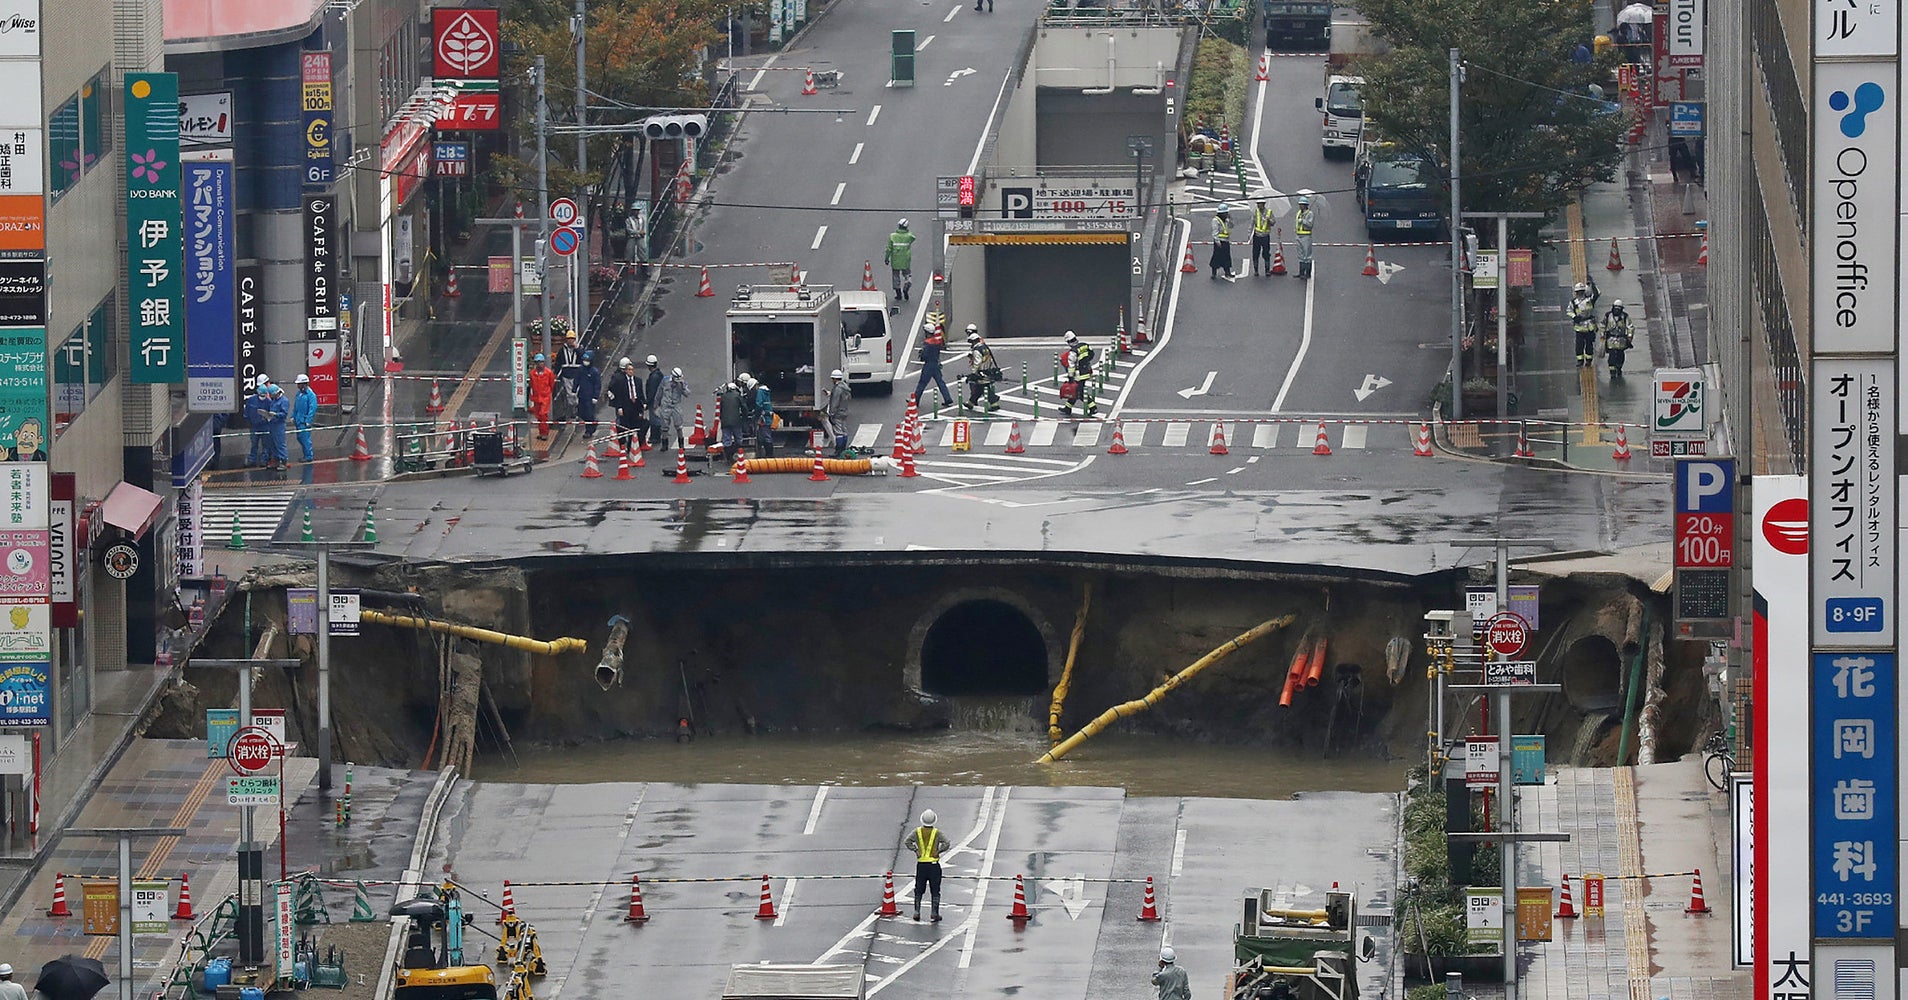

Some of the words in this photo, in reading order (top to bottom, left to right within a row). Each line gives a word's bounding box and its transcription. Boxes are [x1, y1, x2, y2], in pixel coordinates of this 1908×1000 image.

[12, 17, 36, 28] Wise
[305, 54, 329, 68] 24h
[305, 98, 330, 109] 100円
[1167, 97, 1174, 115] 出口
[14, 132, 26, 156] 村田
[436, 147, 466, 158] たばこ
[308, 166, 330, 181] 6F
[436, 162, 466, 175] ATM
[130, 189, 149, 199] IYO
[148, 189, 177, 199] BANK
[216, 169, 225, 207] Dramatic
[556, 206, 572, 219] 40
[1007, 194, 1029, 219] P
[944, 220, 973, 231] 博多駅
[192, 168, 215, 303] アパマンショップ
[216, 208, 225, 271] Communication
[1133, 232, 1142, 243] P
[1827, 147, 1868, 328] Openoffice
[314, 260, 325, 273] de
[1132, 256, 1142, 275] 入口
[138, 219, 171, 367] 伊予銀行
[317, 331, 327, 339] 1F
[242, 341, 255, 358] de
[312, 374, 334, 382] アコム
[1689, 442, 1704, 454] ATM
[1830, 373, 1856, 582] オープンオフィス
[1866, 373, 1881, 567] 1名様から使えるレンタルオフィス
[1687, 463, 1726, 511] P
[1686, 516, 1724, 535] 20分
[1679, 536, 1731, 564] 100円
[1491, 630, 1522, 644] 消火栓
[1487, 664, 1534, 675] とみや歯科
[237, 744, 269, 760] 消火栓
[1831, 656, 1877, 883] 花岡歯科
[240, 779, 277, 788] むらつ歯科
[1817, 892, 1893, 906] 441-3693
[1835, 909, 1875, 933] 3F
